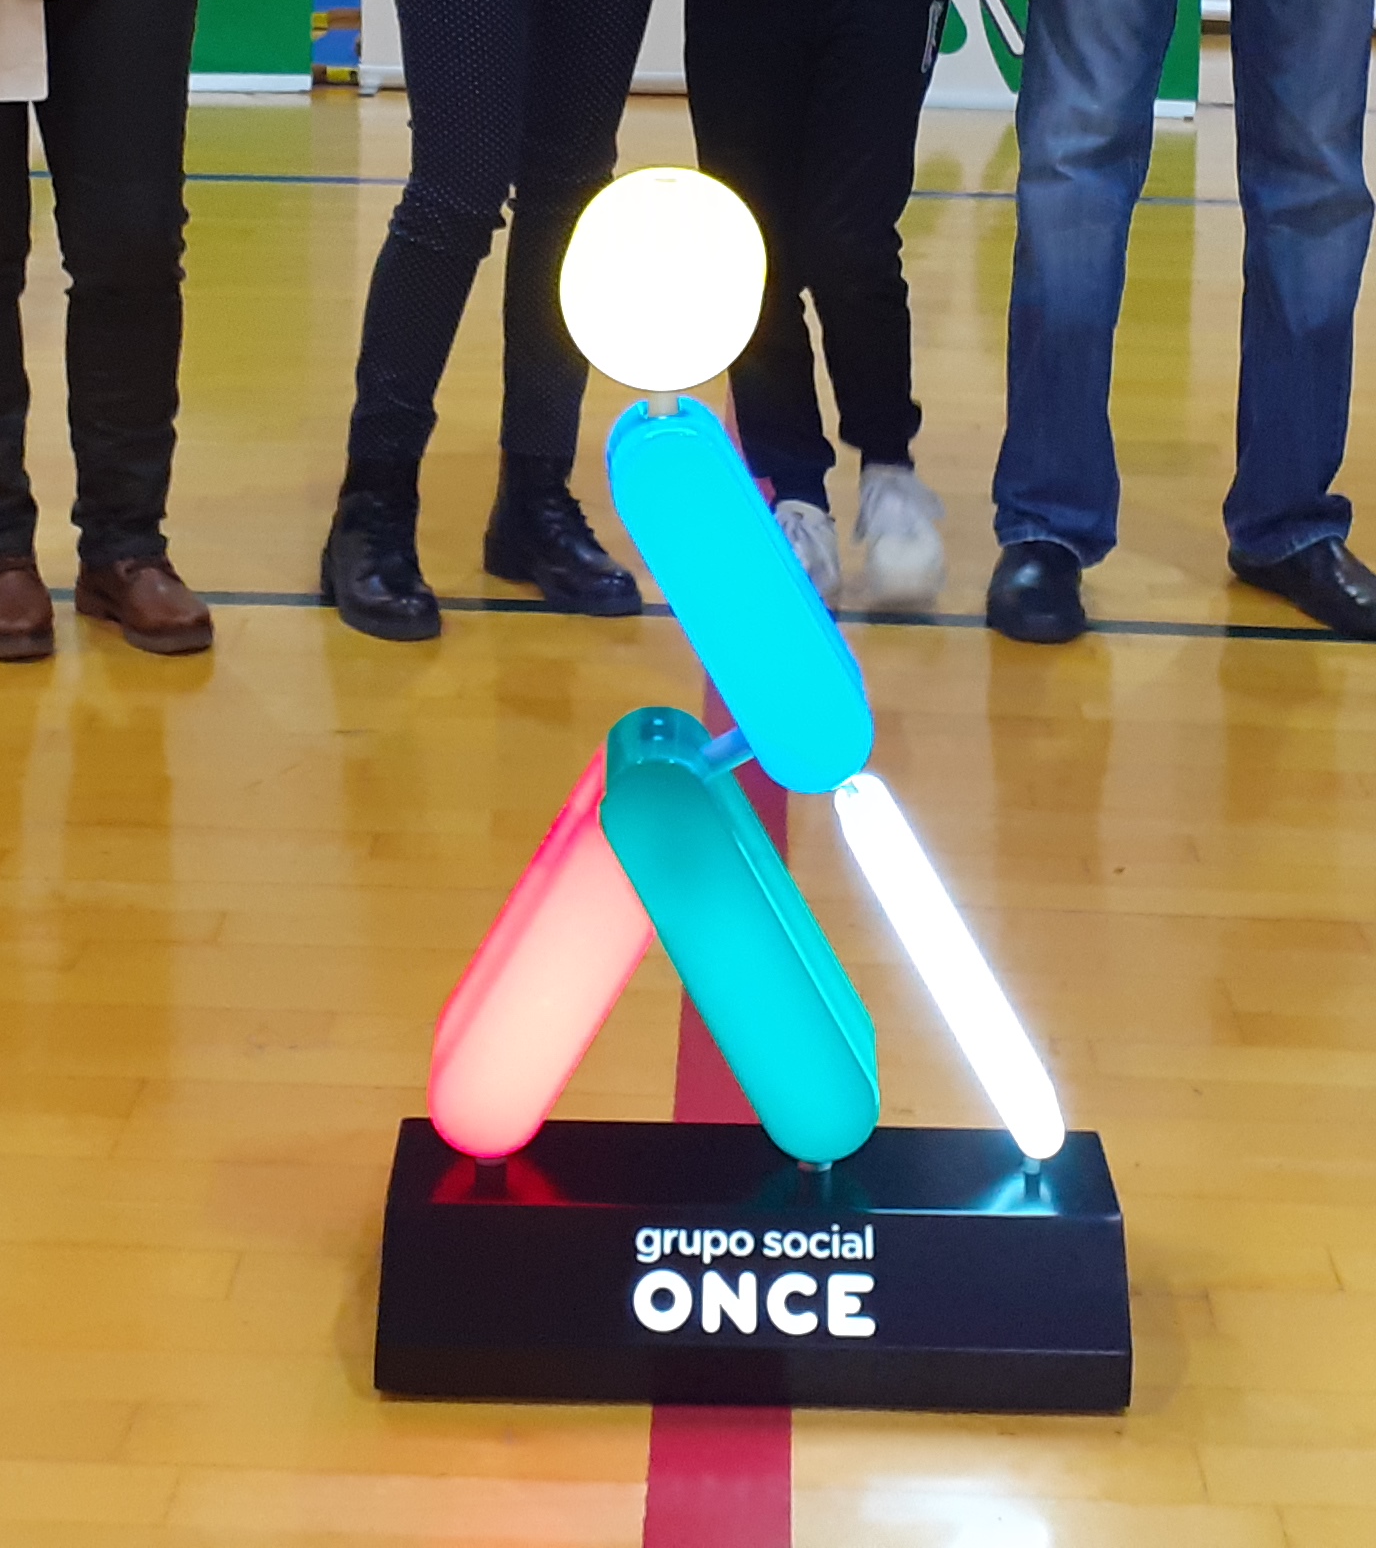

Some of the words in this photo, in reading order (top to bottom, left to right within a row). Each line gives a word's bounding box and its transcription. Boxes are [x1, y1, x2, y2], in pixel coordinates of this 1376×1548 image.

[635, 1227, 755, 1265] grupo
[763, 1223, 875, 1261] social
[633, 1269, 876, 1337] ONCE
